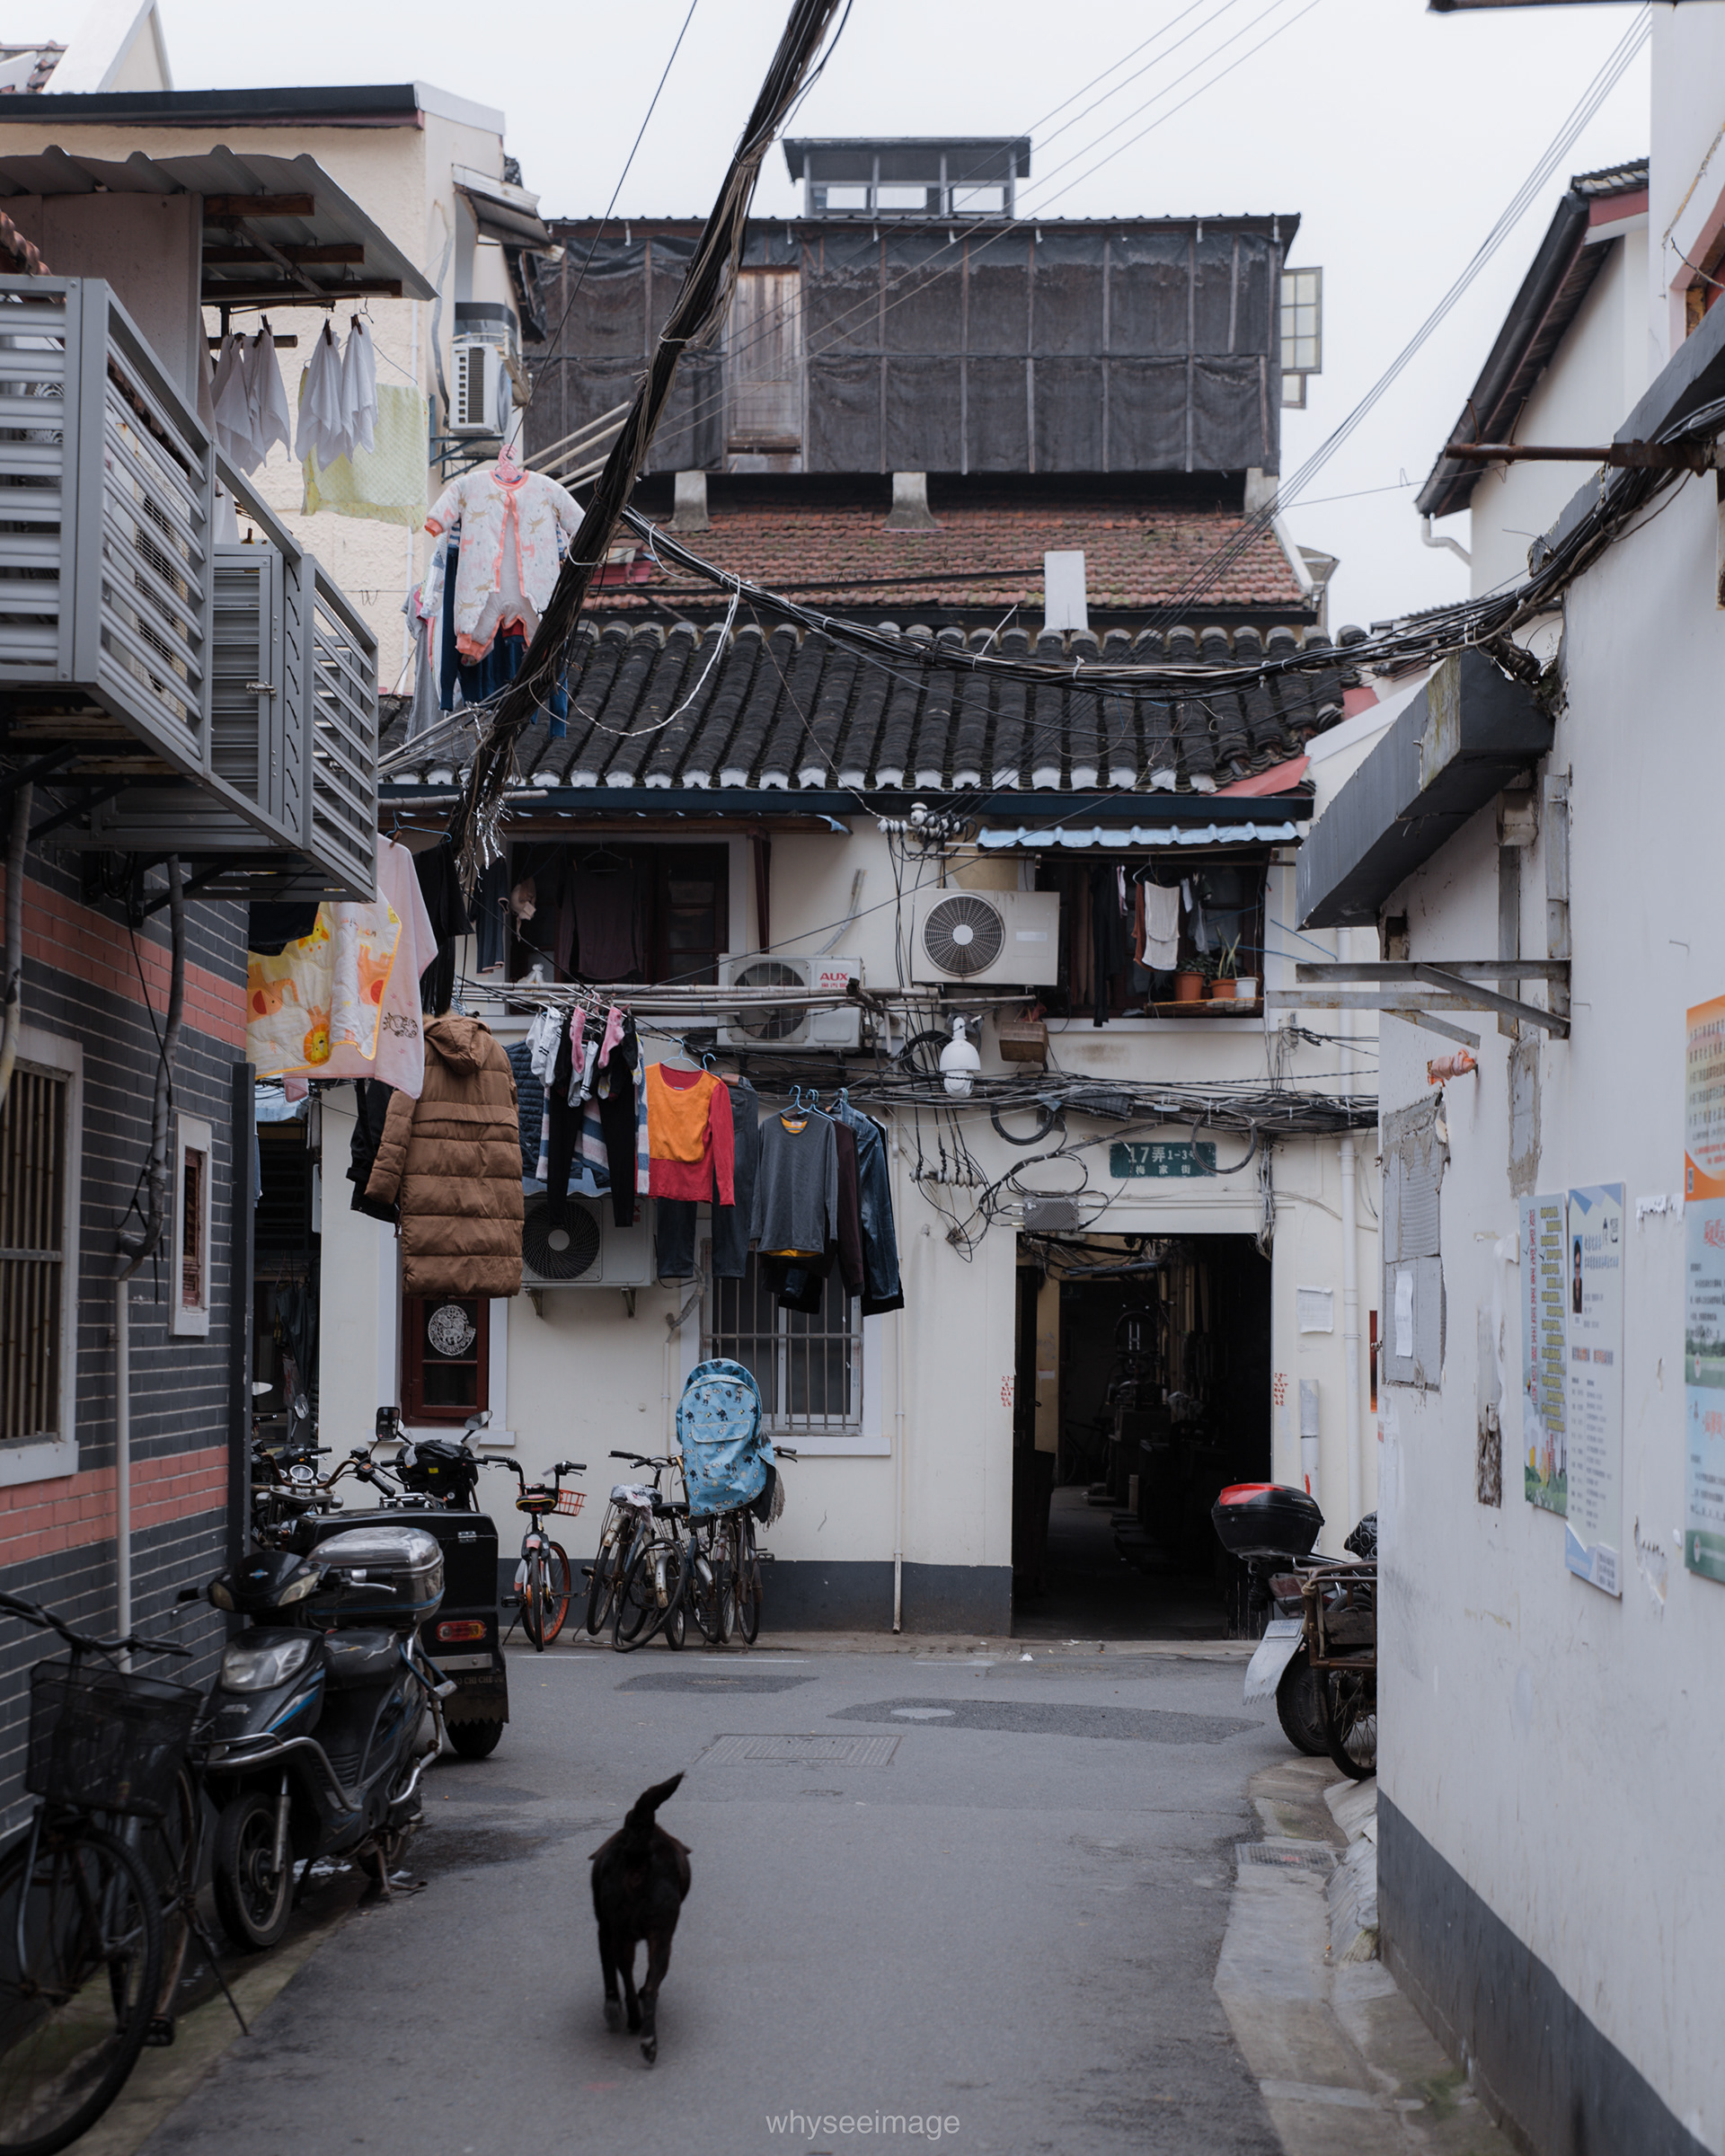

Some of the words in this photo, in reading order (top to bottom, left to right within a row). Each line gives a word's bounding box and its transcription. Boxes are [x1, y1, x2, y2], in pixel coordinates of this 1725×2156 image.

[819, 972, 848, 981] AUX
[1136, 1164, 1190, 1174] 梅家街
[464, 1676, 477, 1684] CHI
